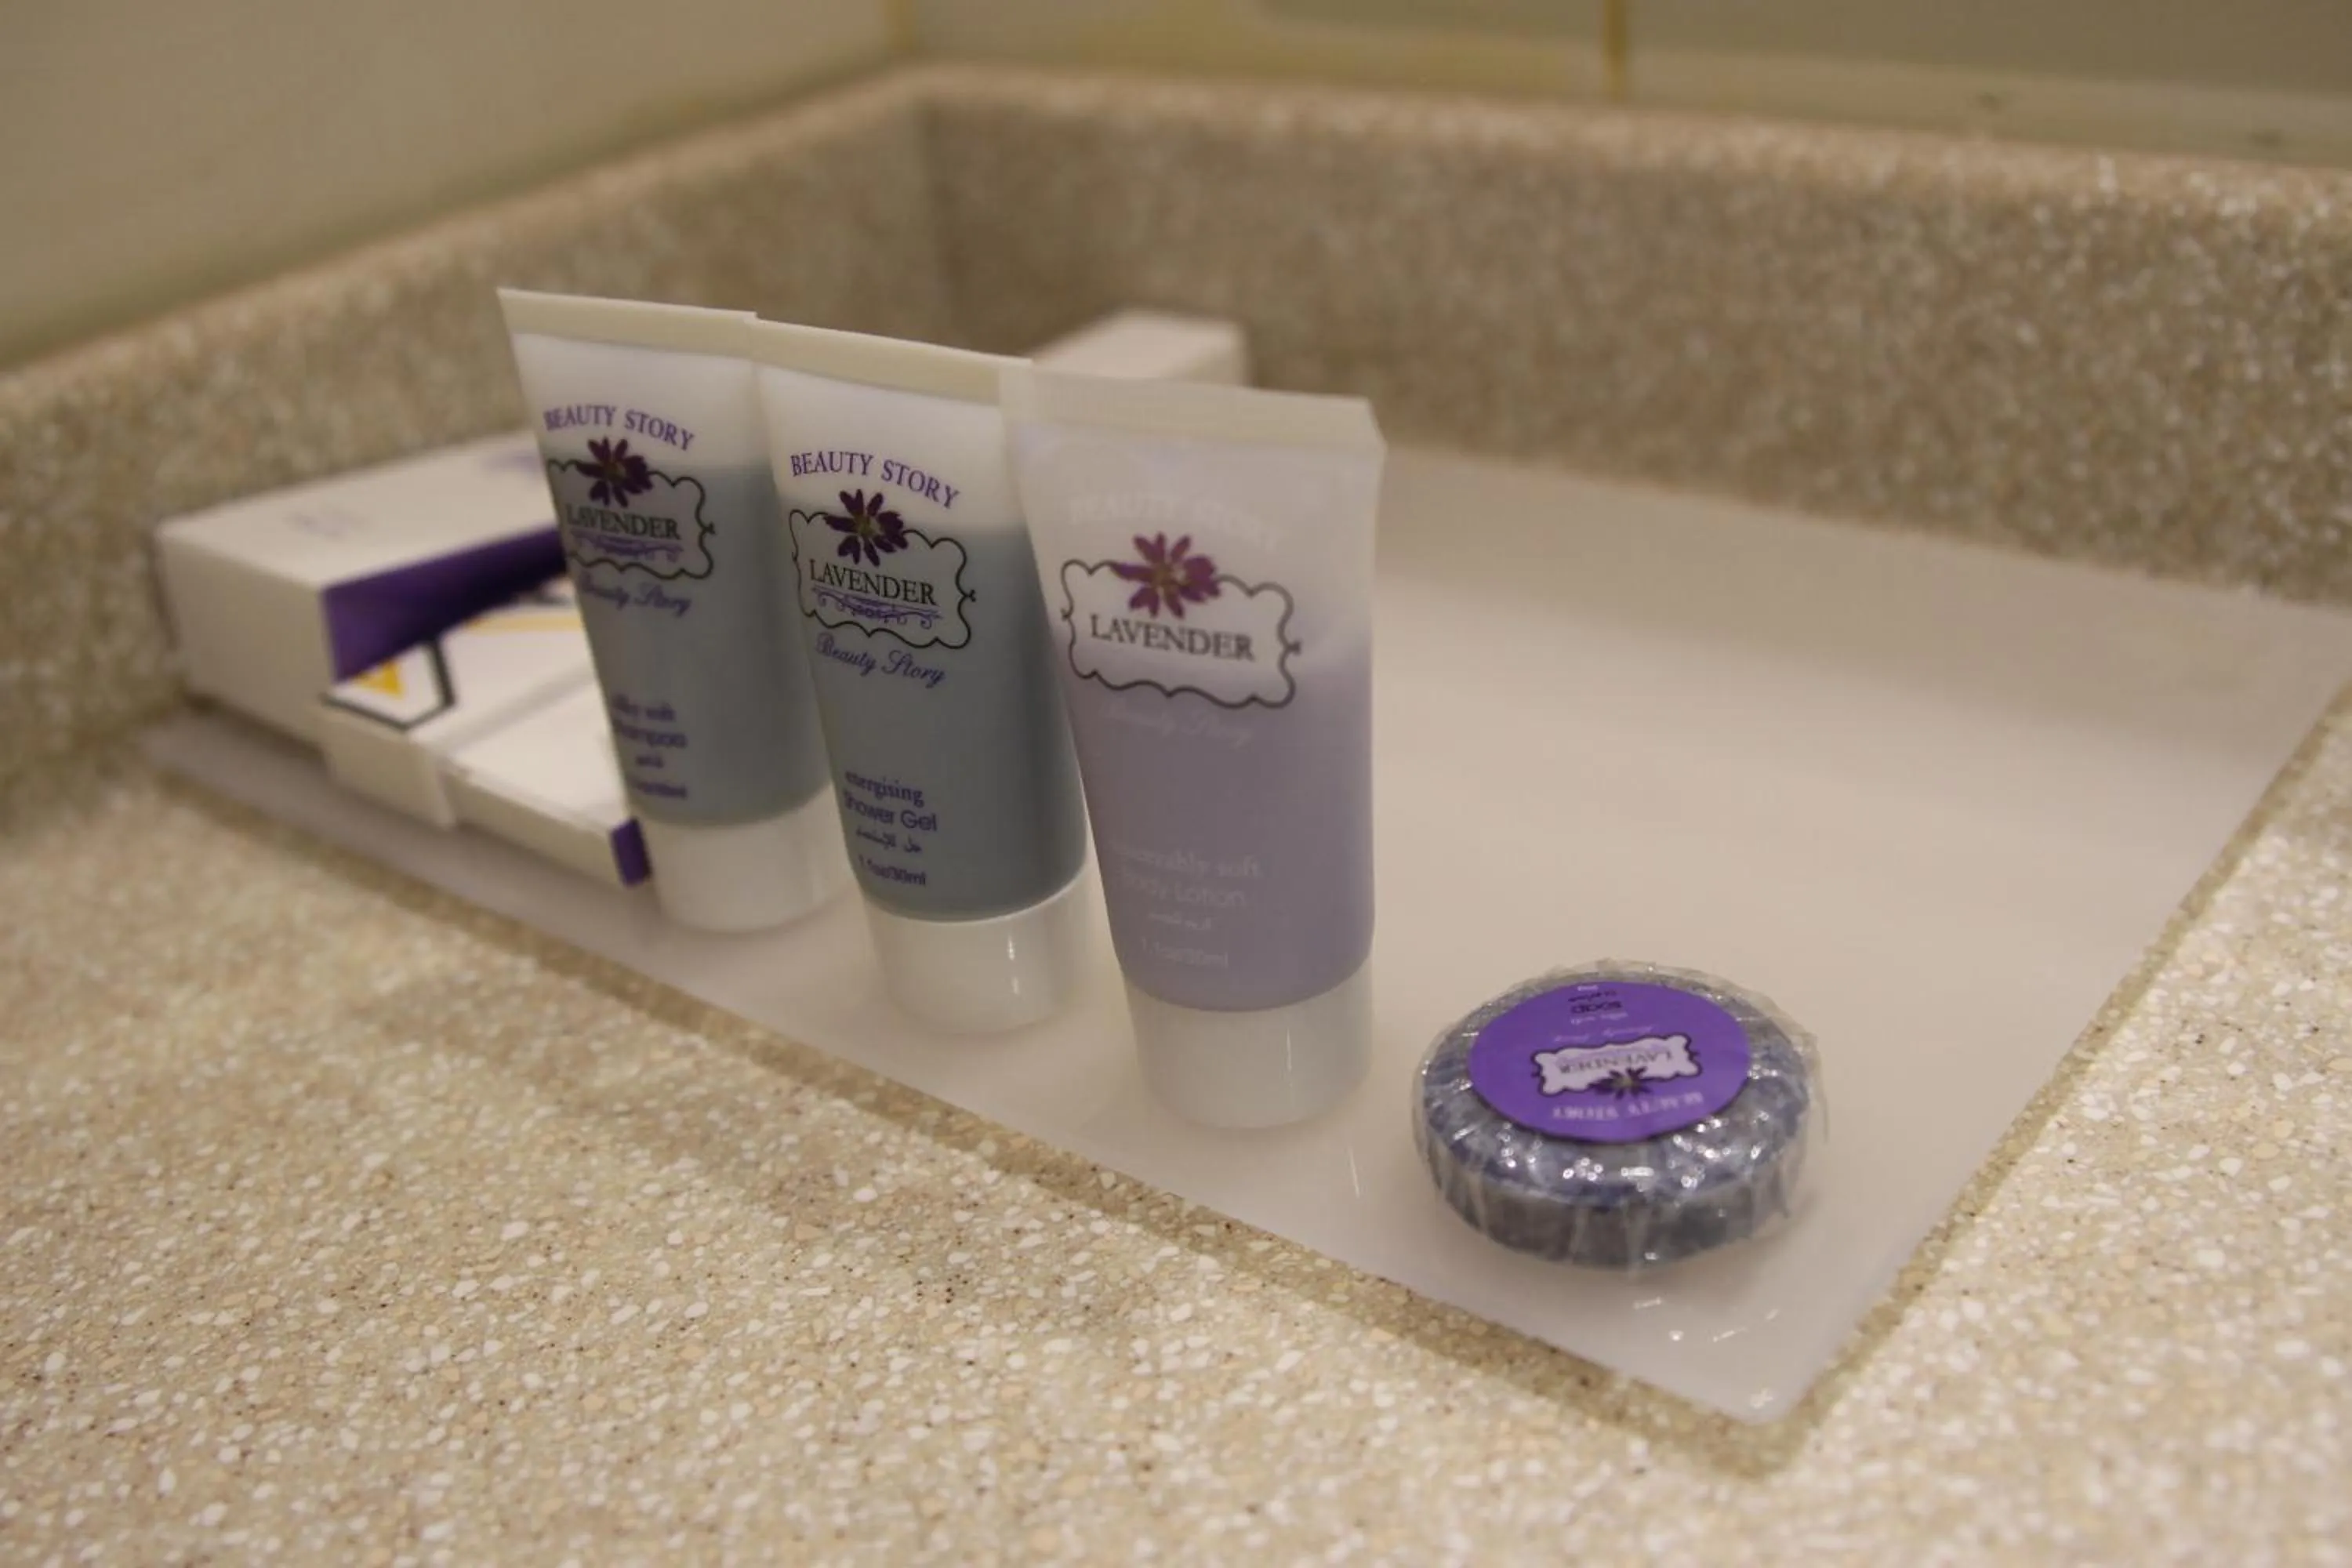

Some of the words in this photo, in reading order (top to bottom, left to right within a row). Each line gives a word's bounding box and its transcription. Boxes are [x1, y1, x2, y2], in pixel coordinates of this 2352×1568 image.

[543, 403, 616, 431] BEAUTY
[624, 409, 695, 452] STORY
[790, 451, 874, 477] BEAUTY
[880, 459, 961, 510] STORY
[565, 503, 681, 541] LAVENDER
[809, 558, 937, 606] LAVENDER
[815, 631, 877, 676] Beauty
[880, 649, 946, 689] Story
[1091, 613, 1256, 662] LAVENDER
[900, 809, 938, 832] Gel
